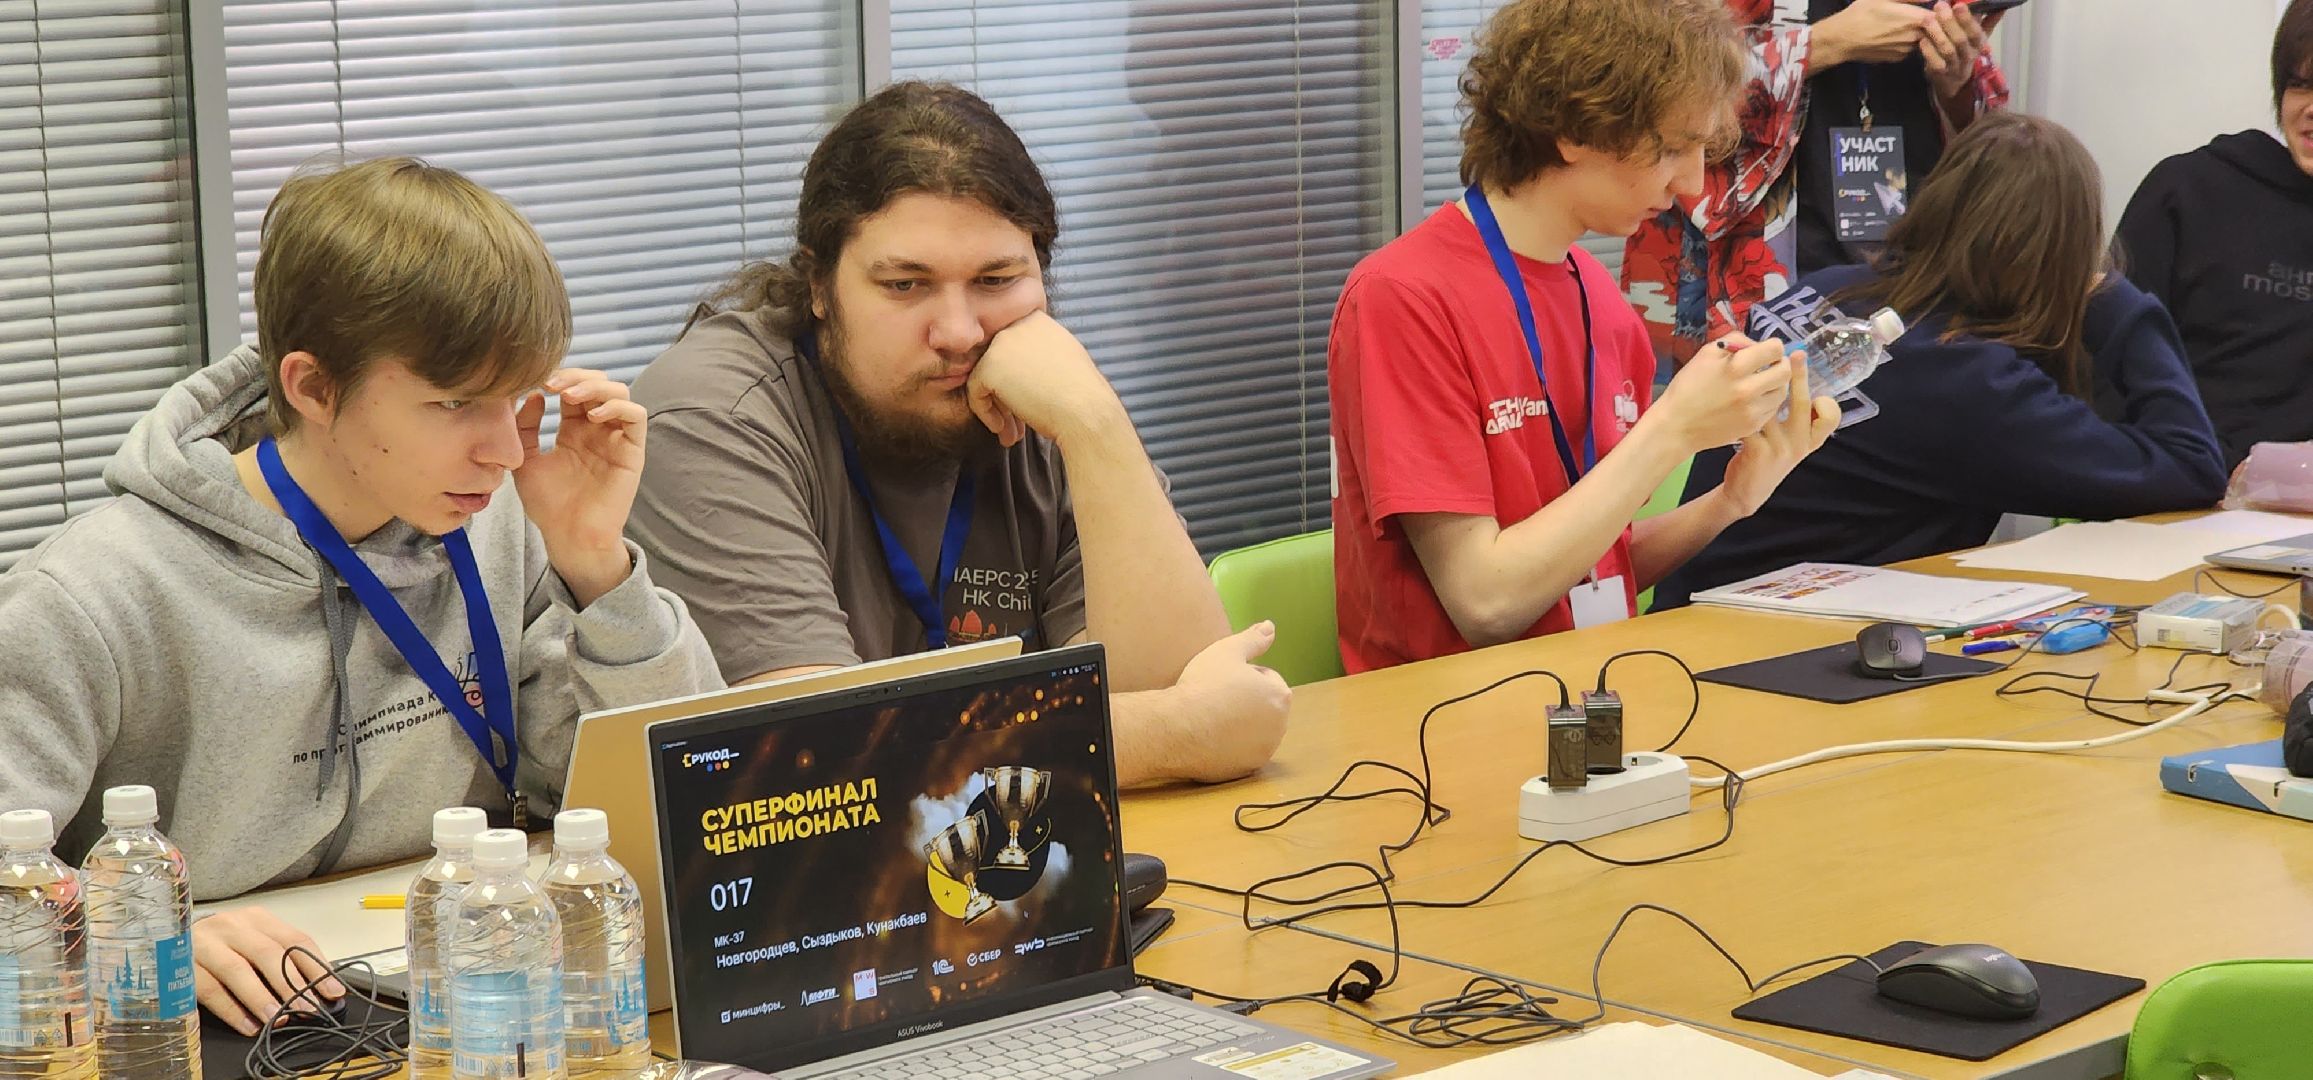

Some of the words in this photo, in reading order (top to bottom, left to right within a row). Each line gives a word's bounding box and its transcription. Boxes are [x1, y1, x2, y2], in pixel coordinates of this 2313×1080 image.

[1840, 136, 1896, 154] УЧАСТ
[1841, 156, 1879, 172] НИК
[1519, 397, 1549, 417] Yan
[962, 588, 992, 608] HK
[293, 752, 308, 764] по
[702, 777, 878, 832] СУПЕРФИНАЛ
[704, 803, 881, 856] ЧЕМПИОНАТА
[711, 877, 753, 911] 017
[714, 930, 745, 949] МК-37
[716, 940, 800, 968] Новгородцев,
[801, 925, 865, 950] Сыздыков,
[866, 911, 928, 936] Кунакбаев
[979, 949, 1002, 963] СБЕР
[897, 1025, 916, 1038] ASUS
[915, 1020, 944, 1034] Vivobook
